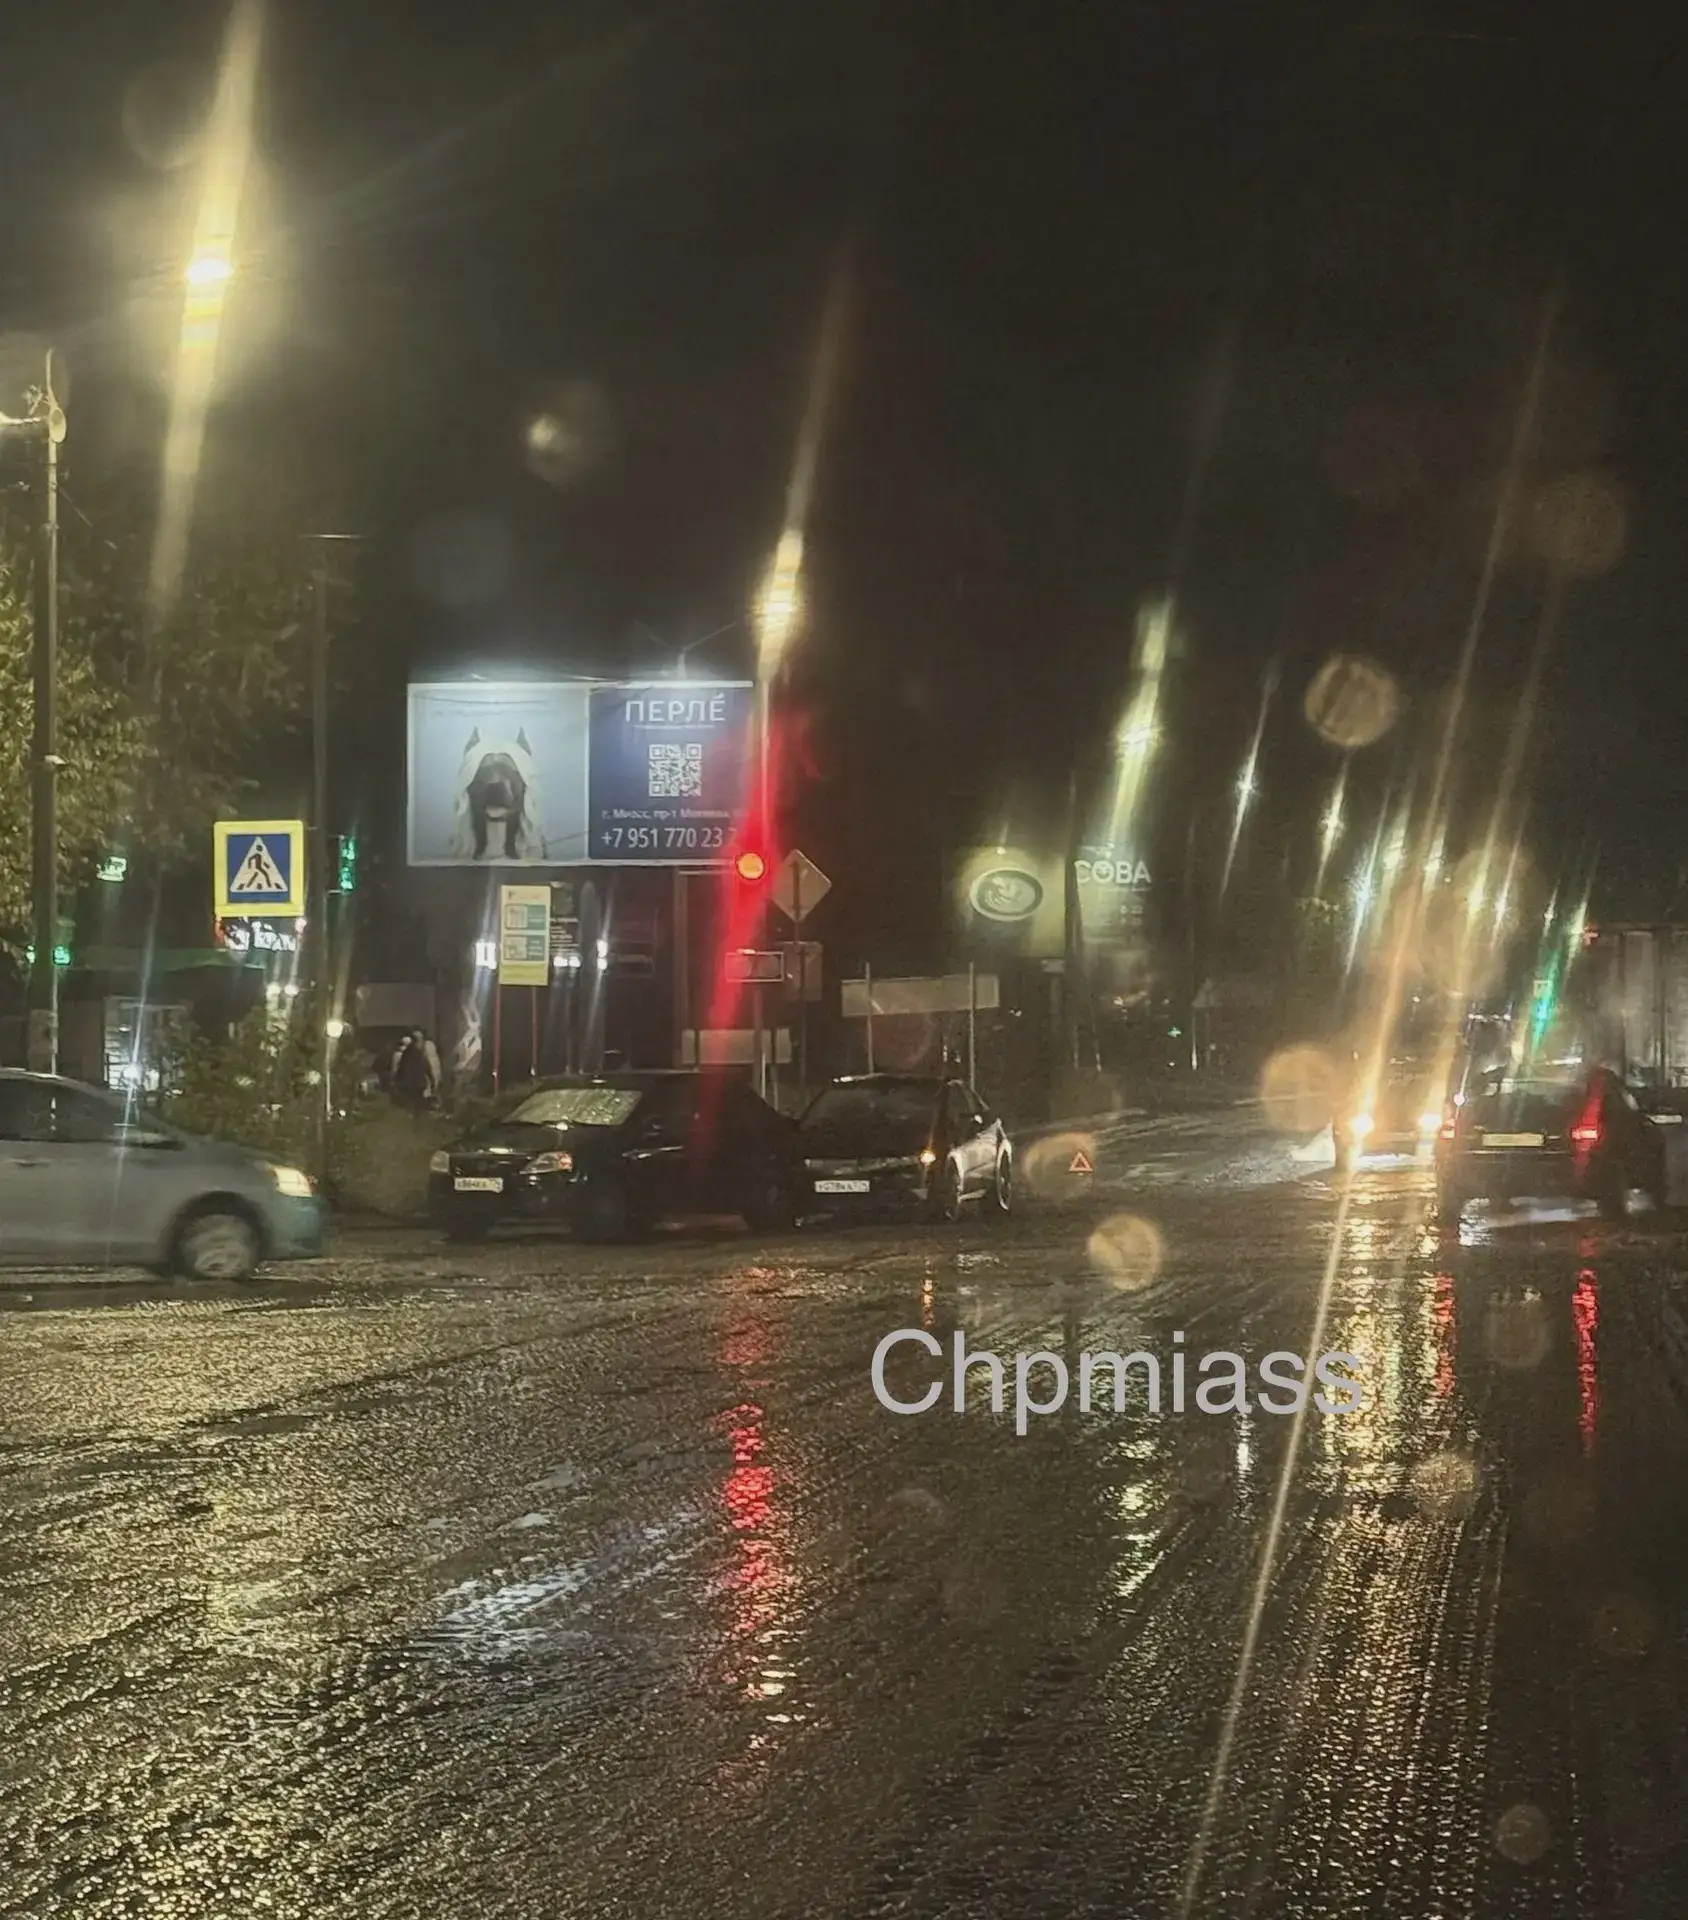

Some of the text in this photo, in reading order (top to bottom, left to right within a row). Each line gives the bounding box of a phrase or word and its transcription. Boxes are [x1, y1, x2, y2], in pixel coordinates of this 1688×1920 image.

[601, 828, 623, 848] +7
[628, 828, 658, 848] 951
[664, 828, 697, 848] 770
[701, 827, 723, 848] 23
[1074, 859, 1152, 884] СОВА
